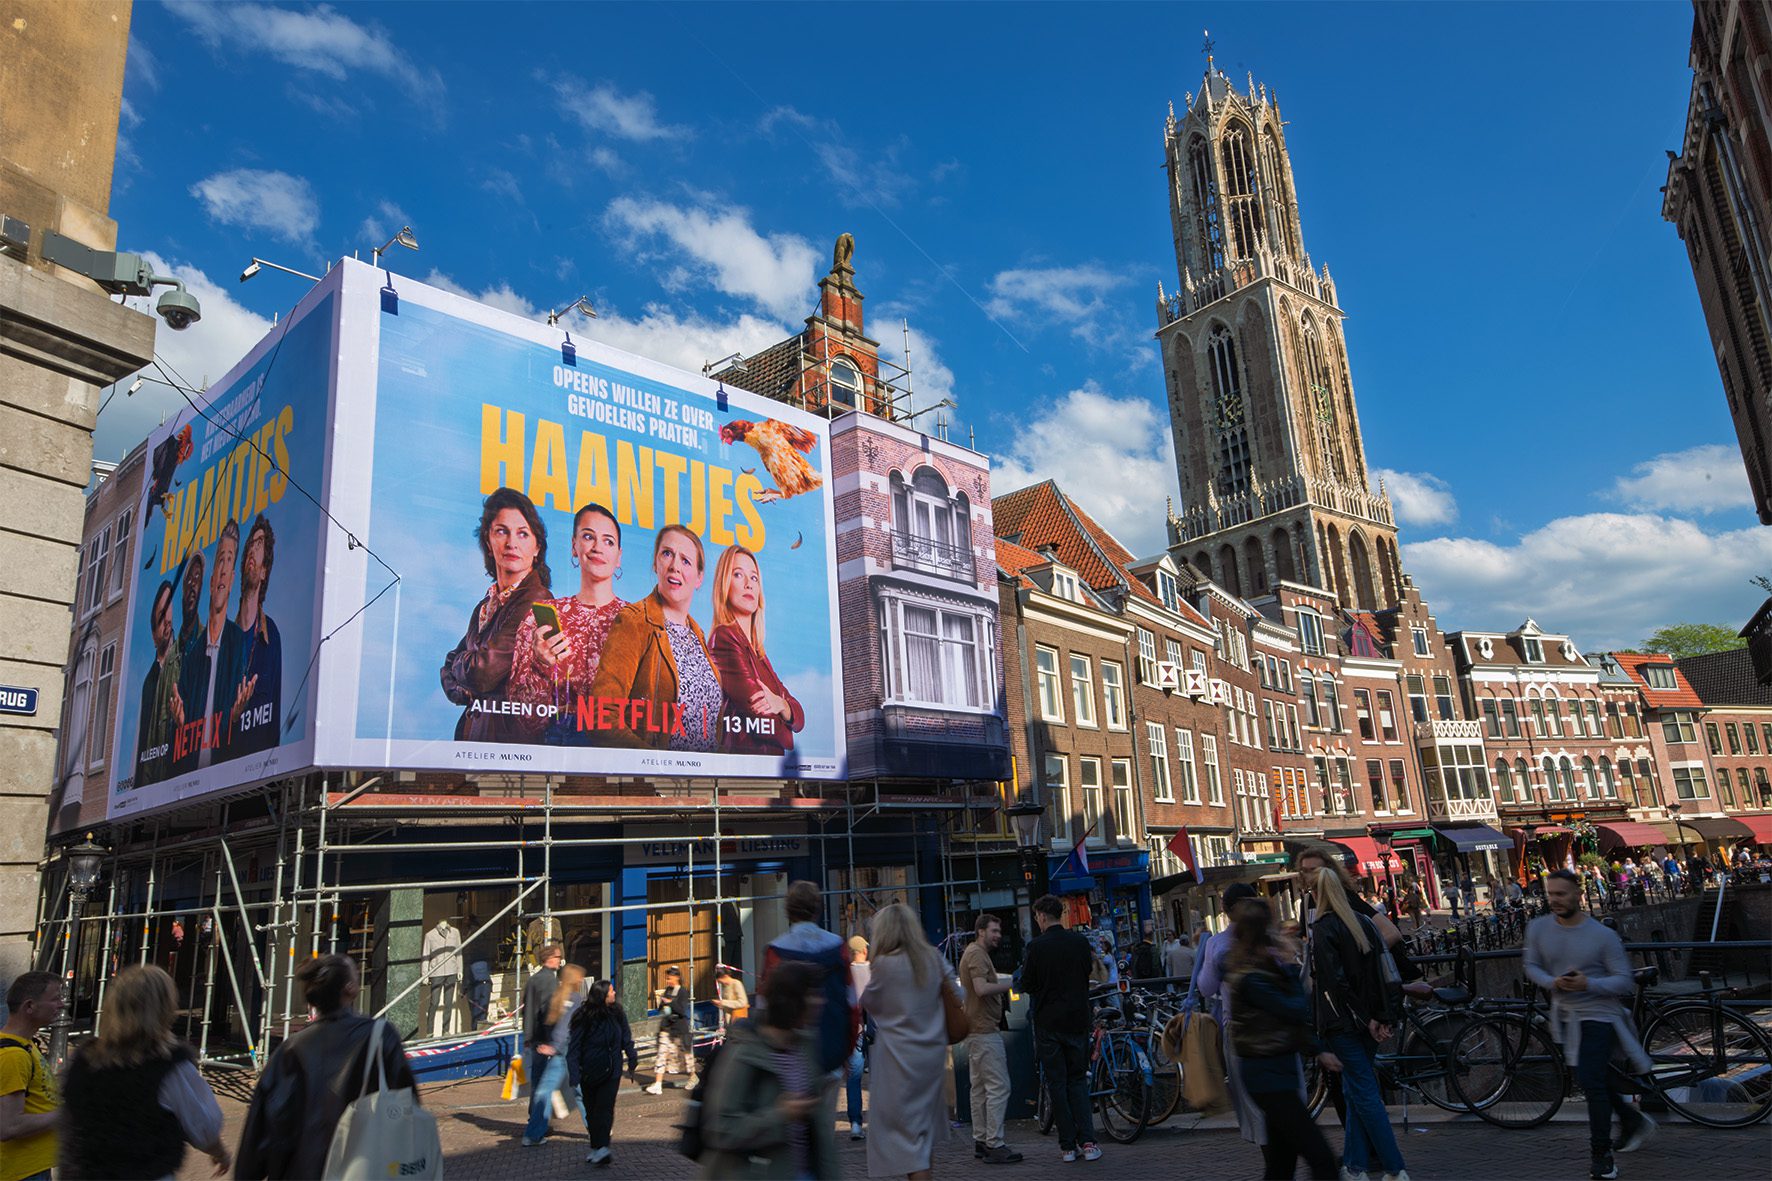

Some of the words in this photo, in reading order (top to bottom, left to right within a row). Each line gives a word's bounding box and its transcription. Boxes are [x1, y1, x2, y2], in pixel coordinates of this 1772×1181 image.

[553, 365, 608, 399] OPEENS
[611, 382, 661, 415] WILLEN
[664, 399, 679, 420] ZE
[682, 404, 714, 431] OVER
[568, 394, 646, 434] GEVOELENS
[649, 417, 702, 450] PRATEN.
[160, 404, 294, 576] HAANTJES
[480, 403, 766, 553] HAANTJES
[140, 746, 161, 763] ALLEEN
[161, 743, 169, 756] OP
[173, 711, 222, 763] NETFLIX
[240, 710, 252, 732] 13
[253, 702, 273, 727] MEI
[471, 699, 532, 716] ALLEEN
[536, 704, 558, 718] OP
[577, 695, 687, 737] NETFLIX
[723, 716, 741, 733] 13
[745, 717, 775, 735] MEI
[455, 751, 495, 760] ATELIER
[500, 753, 532, 761] MUNRO
[641, 758, 673, 766] ATELIER
[676, 760, 702, 768] MUNRO
[642, 841, 714, 857] VELTMAN
[741, 838, 800, 853] LIESTING
[1475, 843, 1498, 851] SUITABLE
